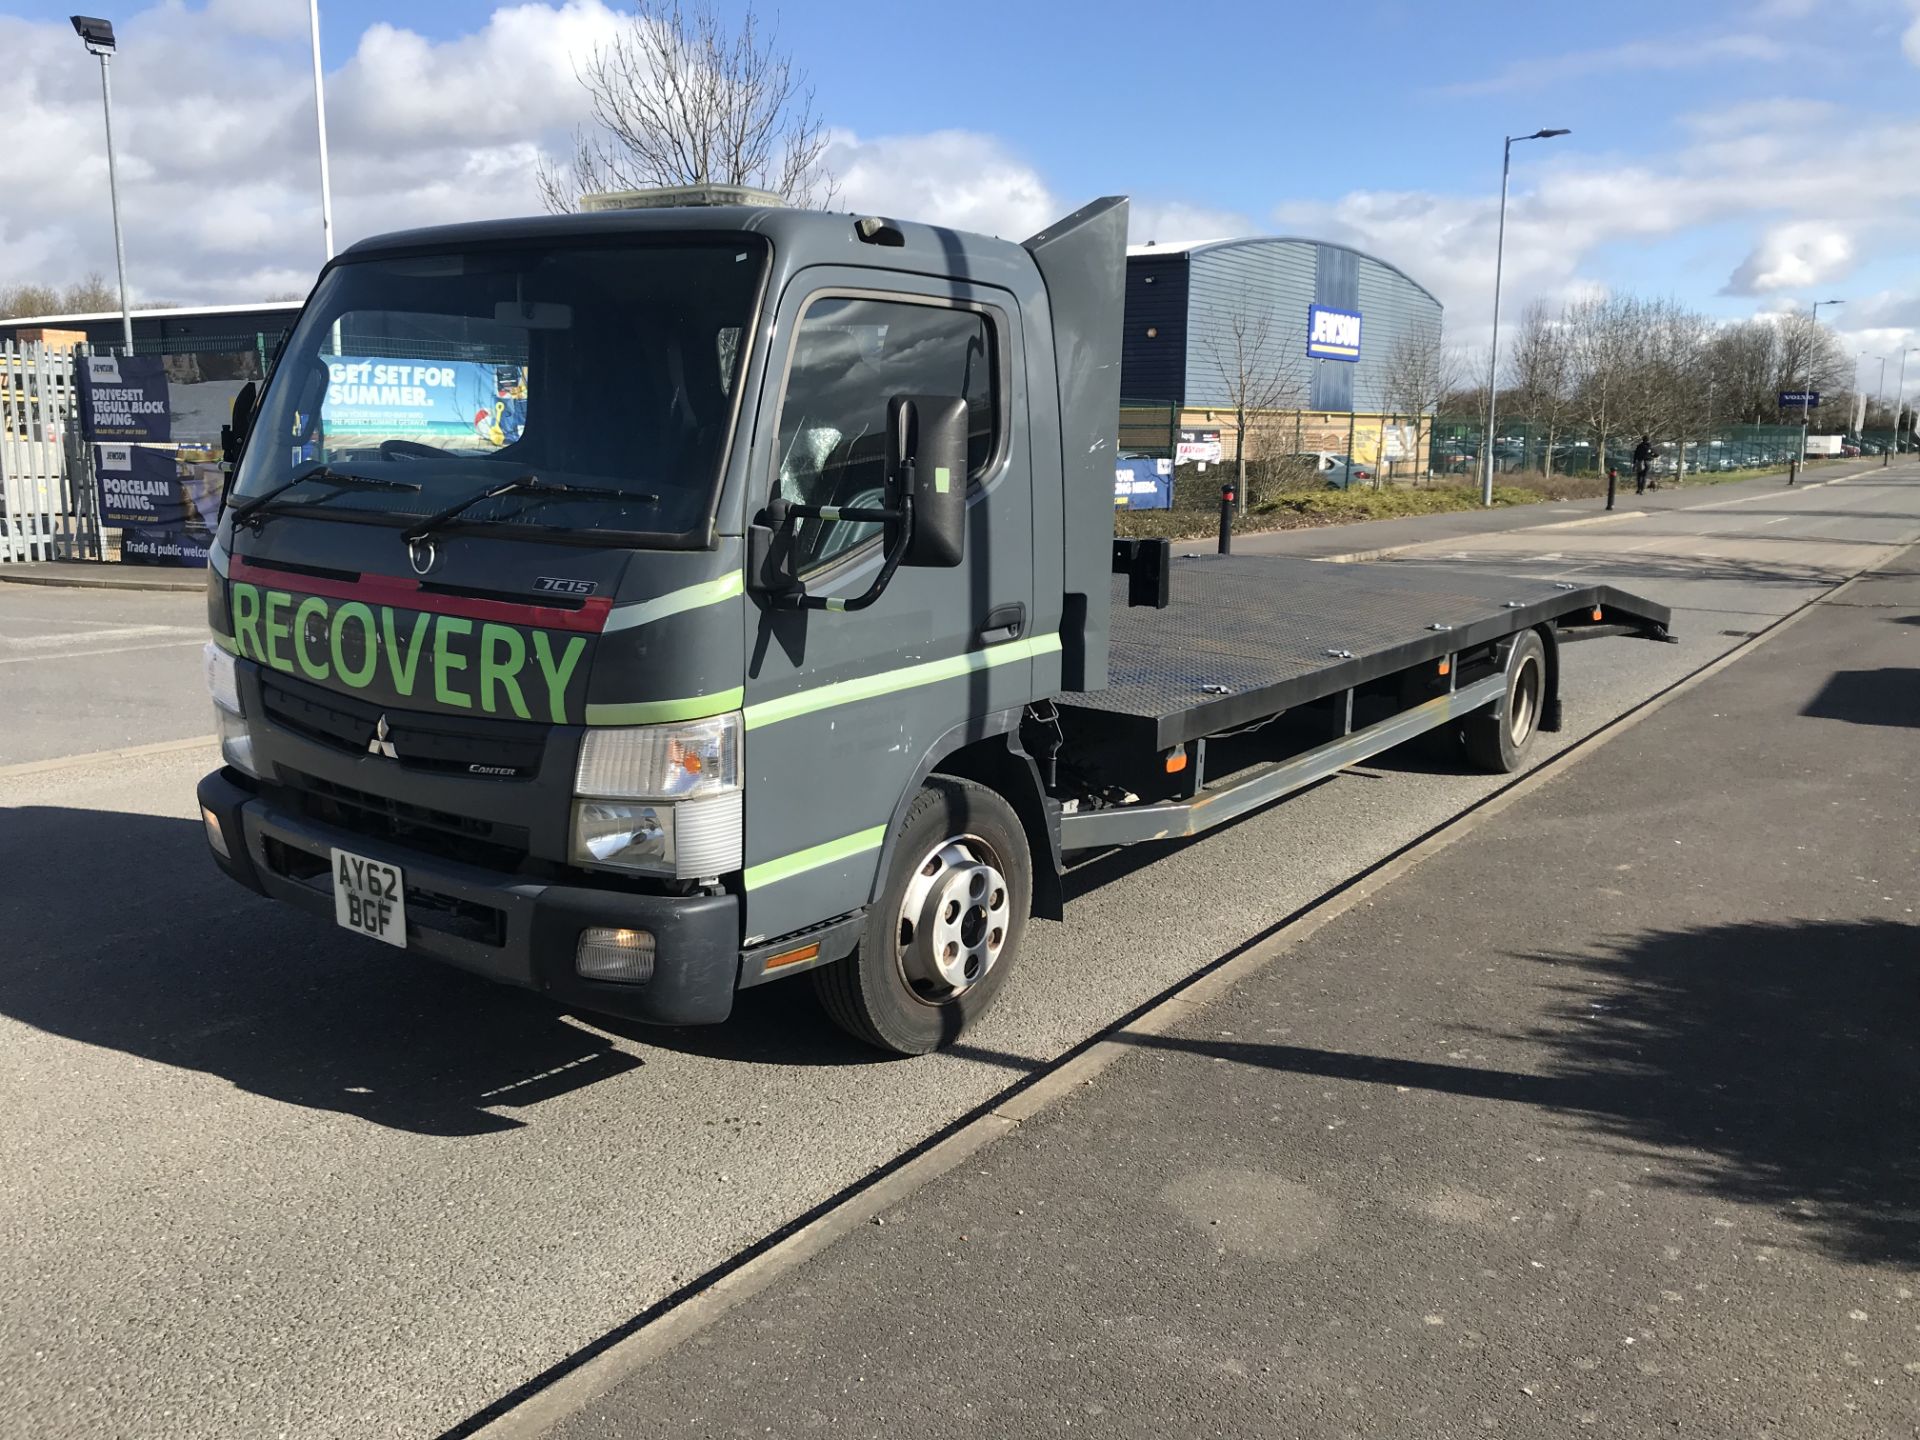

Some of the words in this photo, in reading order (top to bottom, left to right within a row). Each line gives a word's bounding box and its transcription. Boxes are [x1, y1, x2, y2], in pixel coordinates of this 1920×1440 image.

[1311, 310, 1360, 347] JEWSON
[329, 364, 372, 384] GET
[374, 364, 411, 385] SET
[413, 366, 456, 387] FOR
[91, 388, 144, 401] DRIVESETT
[329, 384, 435, 406] SUMMER.
[92, 401, 131, 413] TEGULA
[131, 401, 165, 413] BLOCK
[93, 413, 136, 425] PAVING.
[103, 479, 169, 496] PORCELAIN
[105, 494, 155, 511] PAVING.
[126, 541, 148, 553] Trade
[149, 542, 156, 554] &
[157, 544, 182, 556] public
[233, 583, 586, 724] RECOVERY
[340, 854, 398, 902] AY62
[347, 893, 392, 936] BGF
